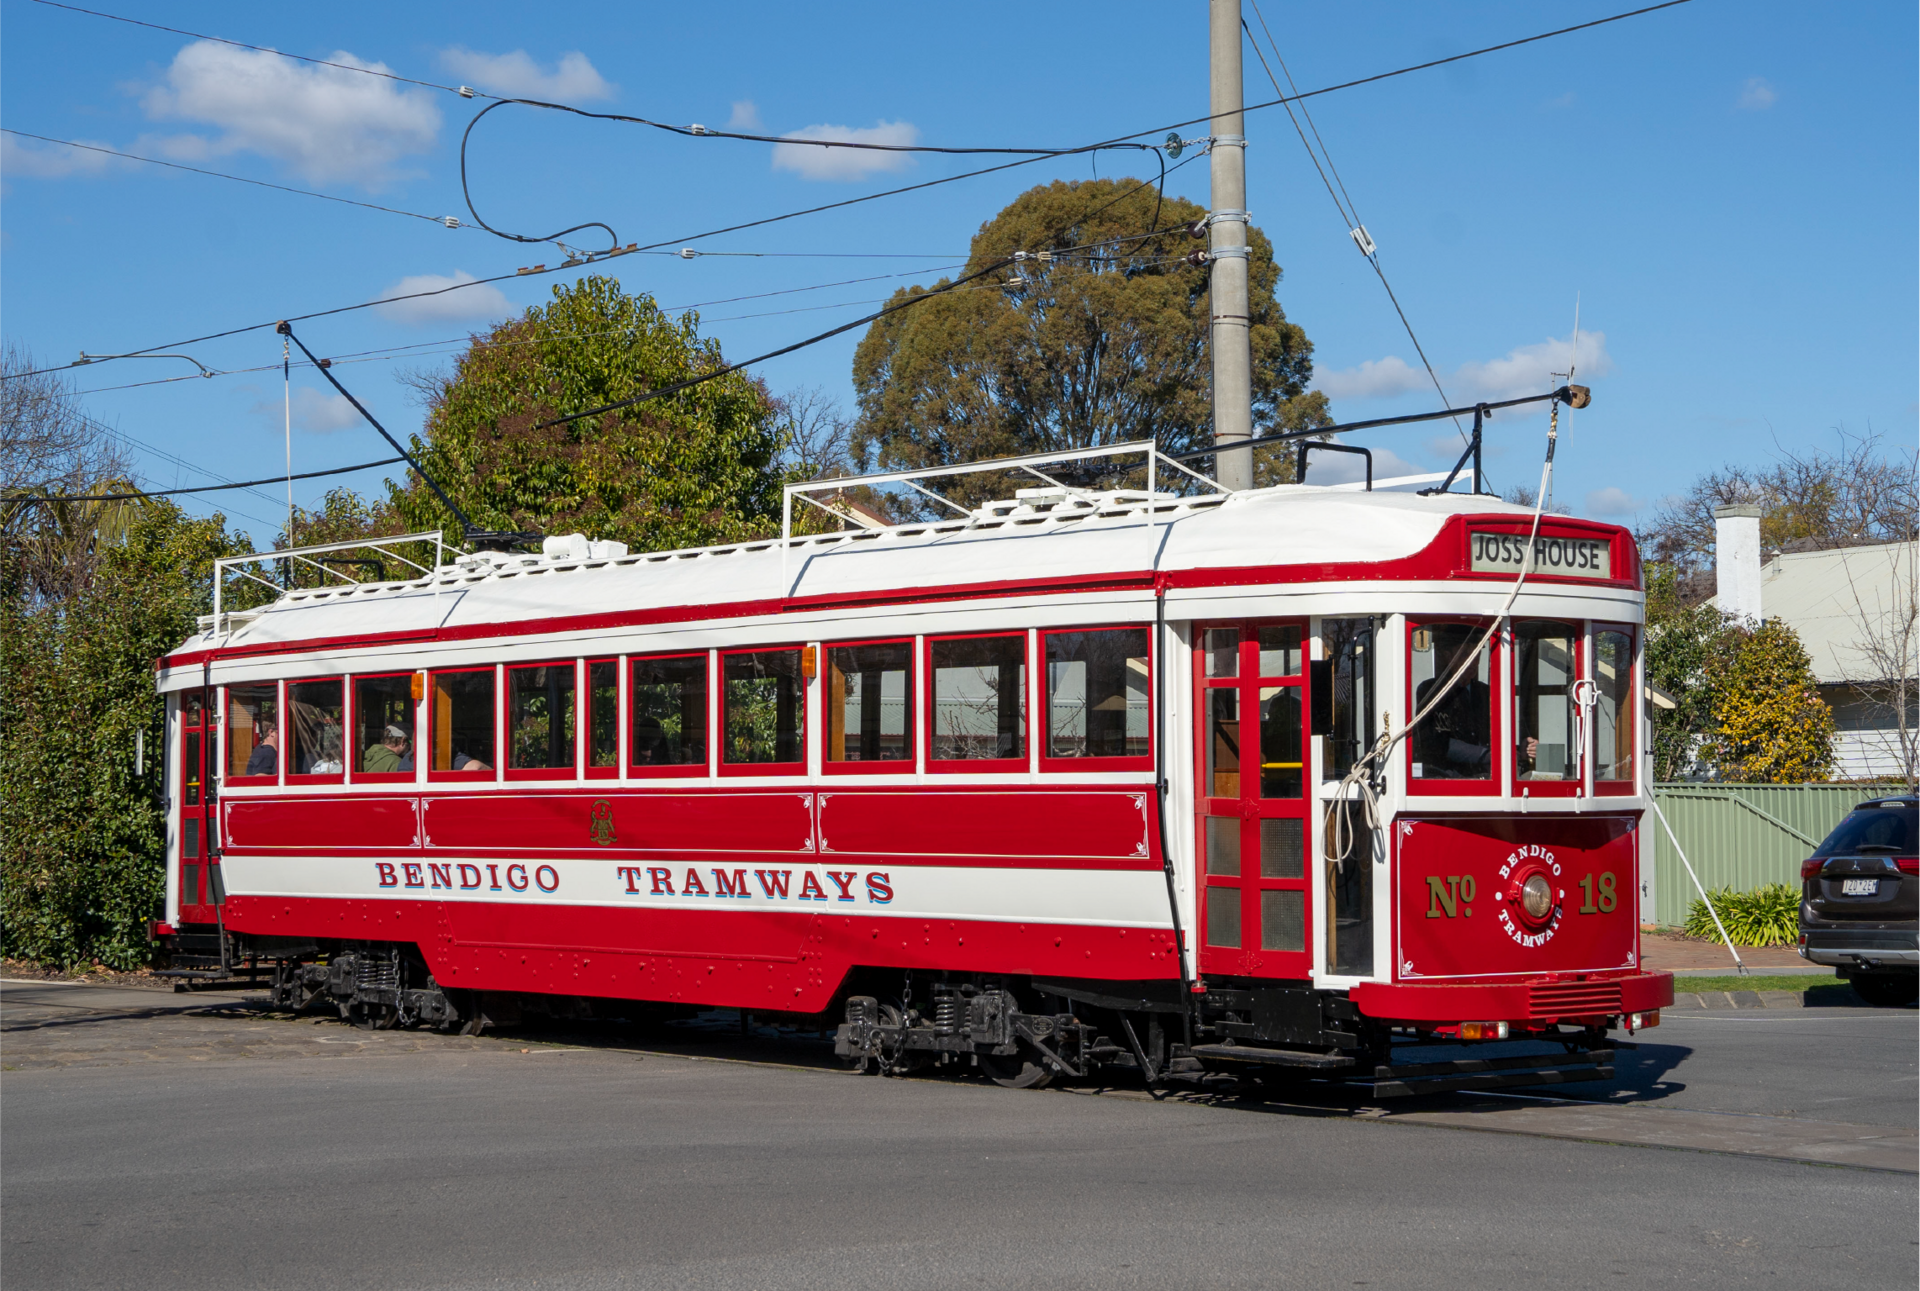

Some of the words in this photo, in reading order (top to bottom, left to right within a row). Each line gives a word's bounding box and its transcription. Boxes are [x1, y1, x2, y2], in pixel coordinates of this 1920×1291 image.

[1475, 535, 1524, 564] JOSS
[1534, 538, 1600, 570] HOUSE
[1419, 630, 1424, 648] 1
[1499, 844, 1561, 879] BENDIGO
[375, 862, 560, 893] BENDIGO
[616, 866, 894, 904] TRAMWAYS
[1579, 871, 1617, 914] 18
[1498, 906, 1563, 948] TRAMWAYS
